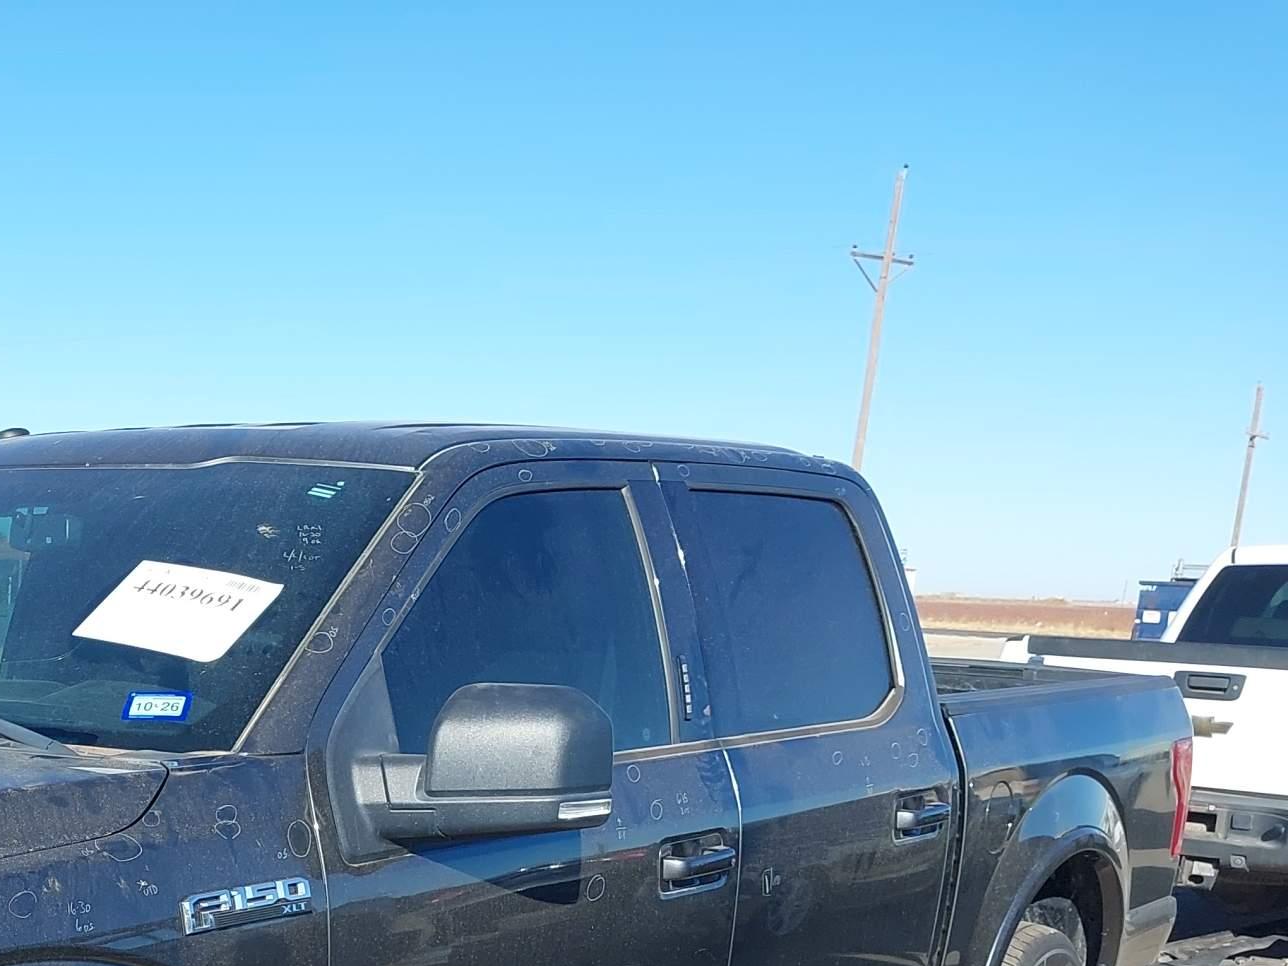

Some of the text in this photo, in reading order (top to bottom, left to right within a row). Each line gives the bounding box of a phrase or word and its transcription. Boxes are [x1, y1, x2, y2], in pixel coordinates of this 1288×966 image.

[133, 579, 245, 612] 44039691
[179, 876, 312, 936] F150
[281, 901, 307, 914] XLT
